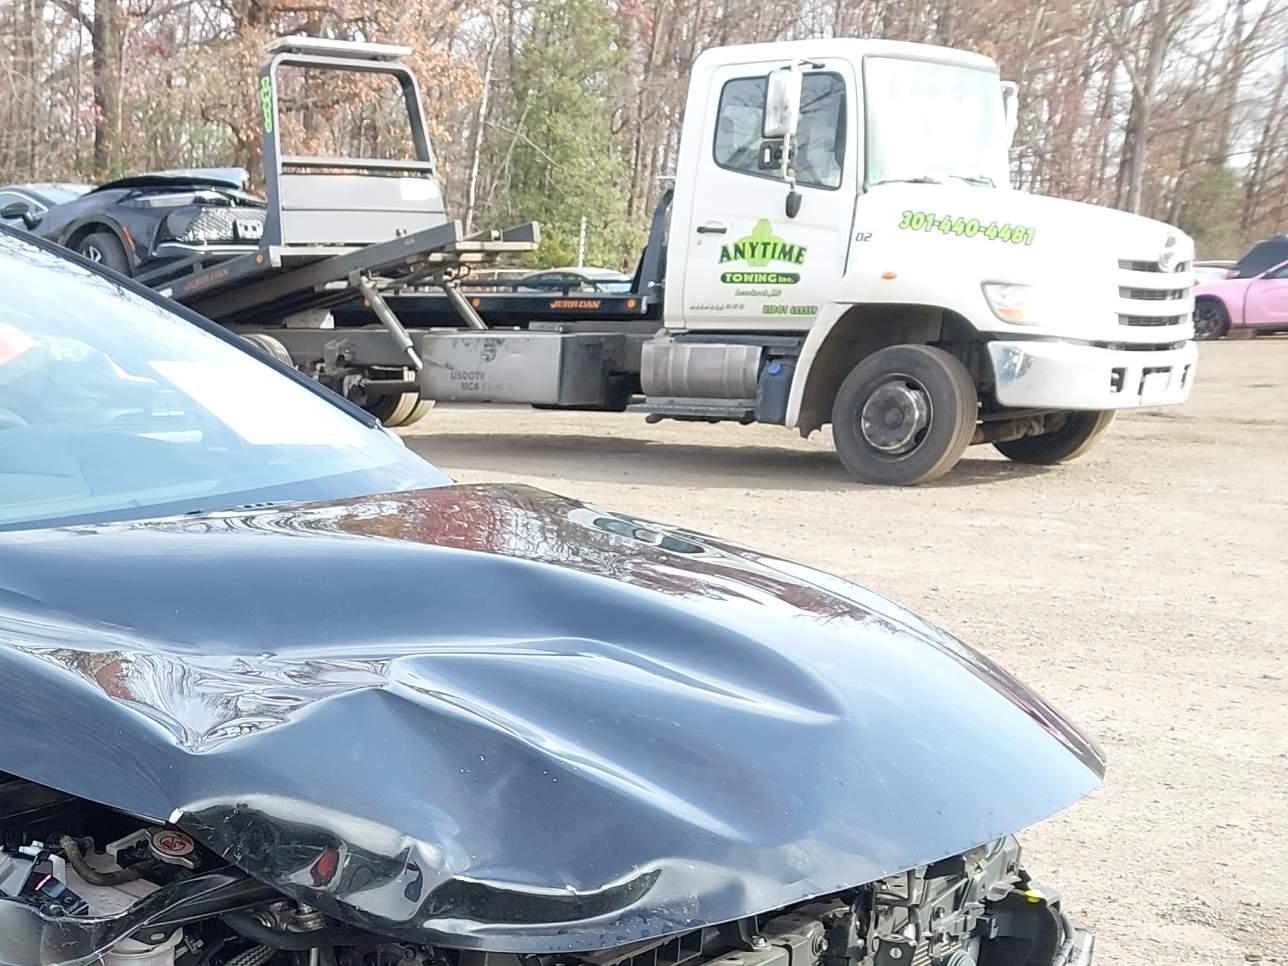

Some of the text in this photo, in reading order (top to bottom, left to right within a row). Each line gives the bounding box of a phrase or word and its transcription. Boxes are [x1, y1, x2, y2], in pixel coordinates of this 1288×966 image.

[899, 210, 1036, 246] 301-440-4481
[855, 232, 872, 242] 02
[718, 241, 807, 265] ANYTIME
[725, 272, 777, 283] TOWING
